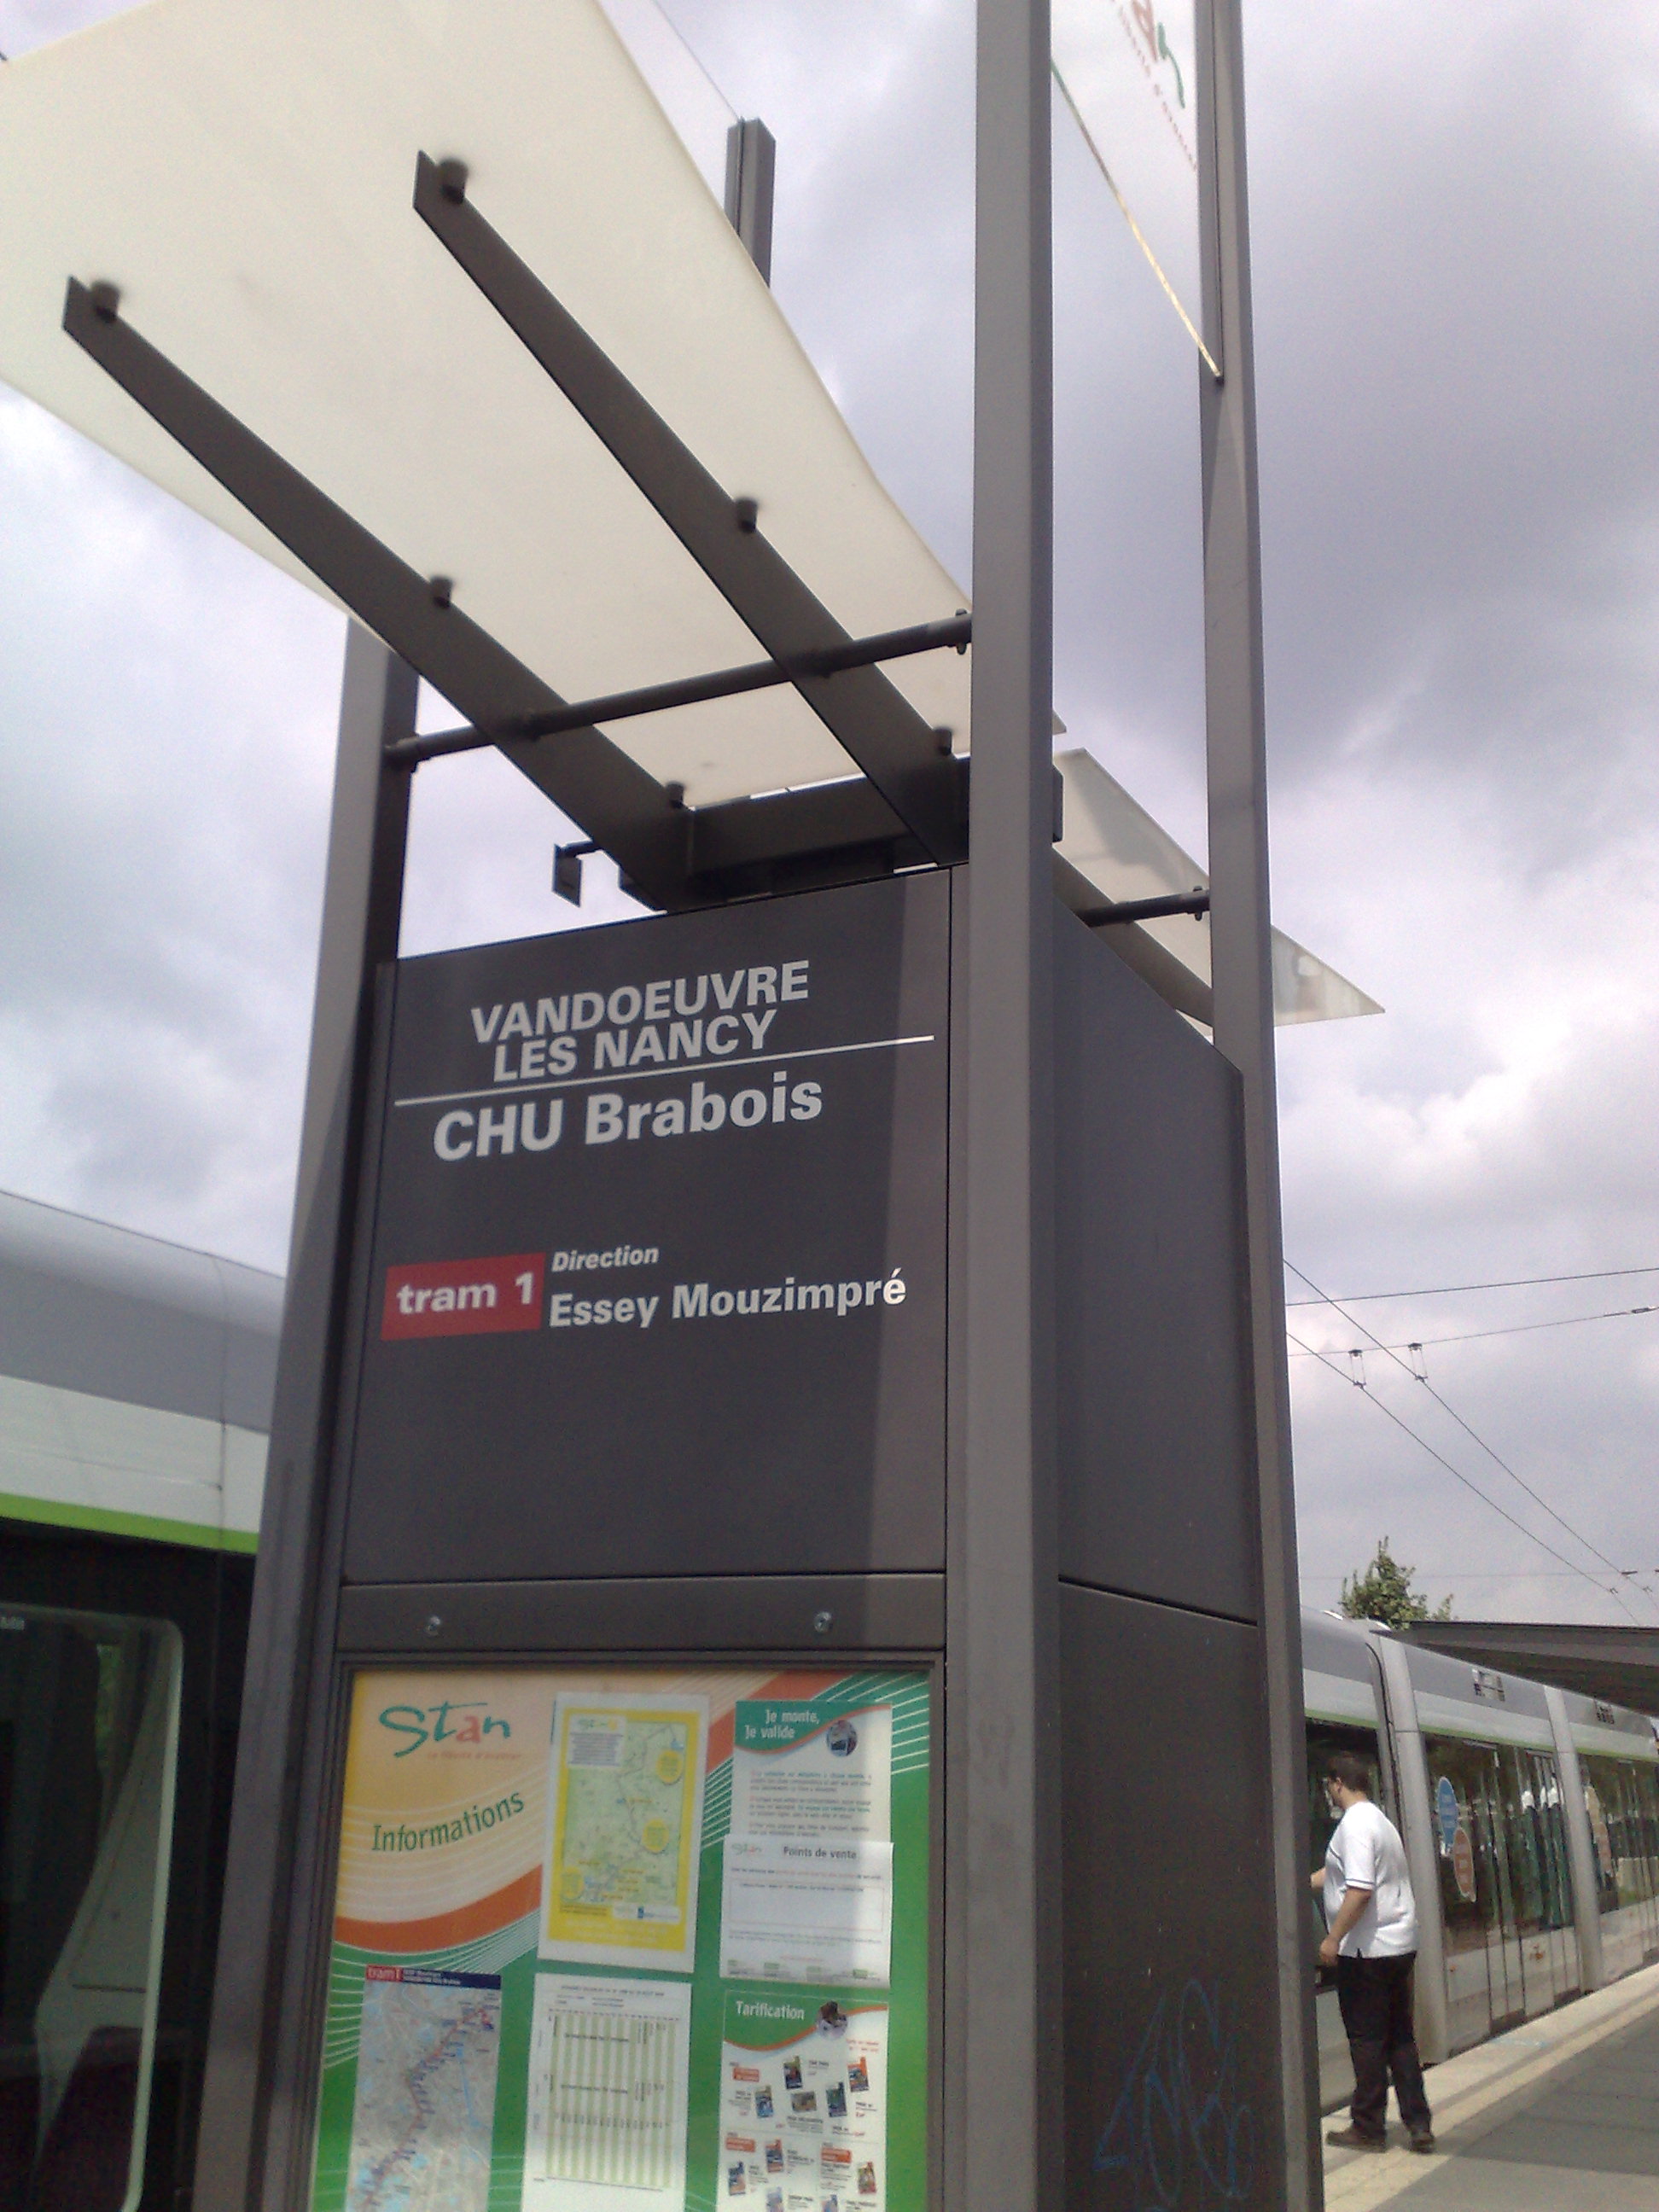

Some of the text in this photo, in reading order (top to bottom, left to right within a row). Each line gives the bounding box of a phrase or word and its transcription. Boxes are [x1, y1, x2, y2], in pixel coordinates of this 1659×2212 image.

[470, 959, 810, 1044] VANDOEUVRE
[493, 1008, 778, 1083] LES NANCY
[433, 1071, 823, 1162] CHU Brabois
[551, 1244, 660, 1273] Direction
[396, 1272, 535, 1315] tram 1
[549, 1267, 907, 1329] Essey Mouzimpré
[379, 1701, 511, 1758] Stan
[745, 1724, 795, 1739] Je valide
[765, 1708, 777, 1724] Je
[371, 1792, 525, 1853] Informations
[783, 1846, 858, 1860] Points de vente
[736, 2000, 806, 2021] Tarification
